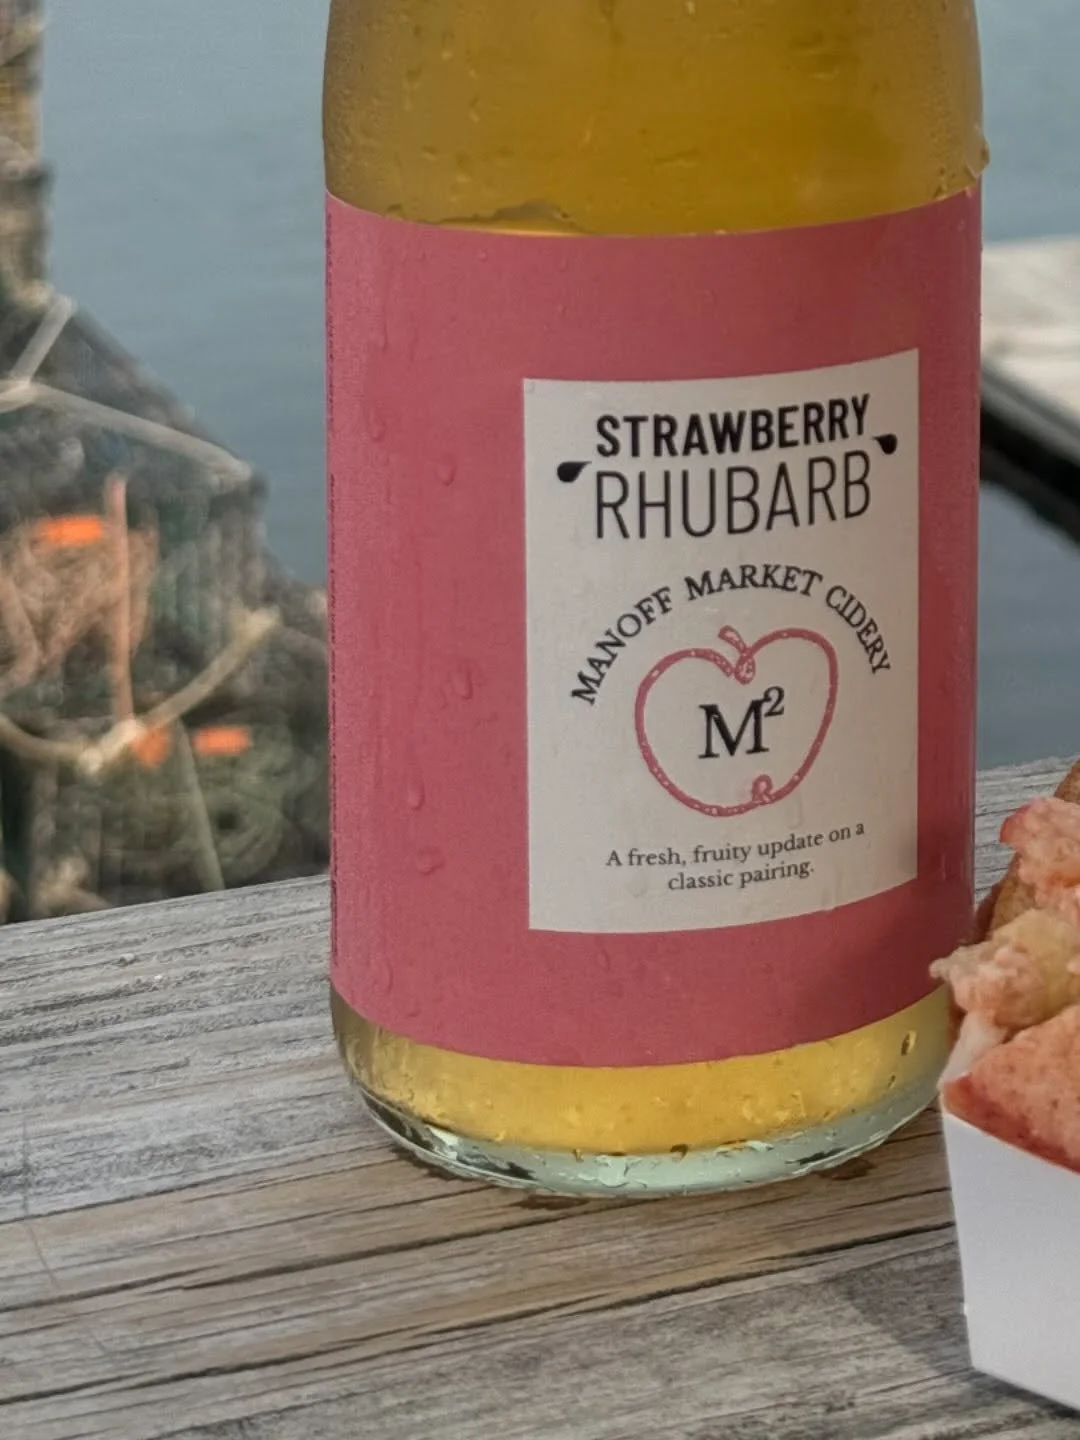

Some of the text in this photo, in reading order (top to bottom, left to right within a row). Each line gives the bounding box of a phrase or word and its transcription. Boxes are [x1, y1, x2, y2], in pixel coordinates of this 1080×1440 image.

[596, 393, 870, 458] STRAWBERRY
[595, 449, 871, 540] RHUBARB
[570, 563, 891, 706] MANOFF MARKET CIDERY
[605, 823, 865, 867] A fresh, fruity update on a
[667, 860, 815, 891] classic pairing.
